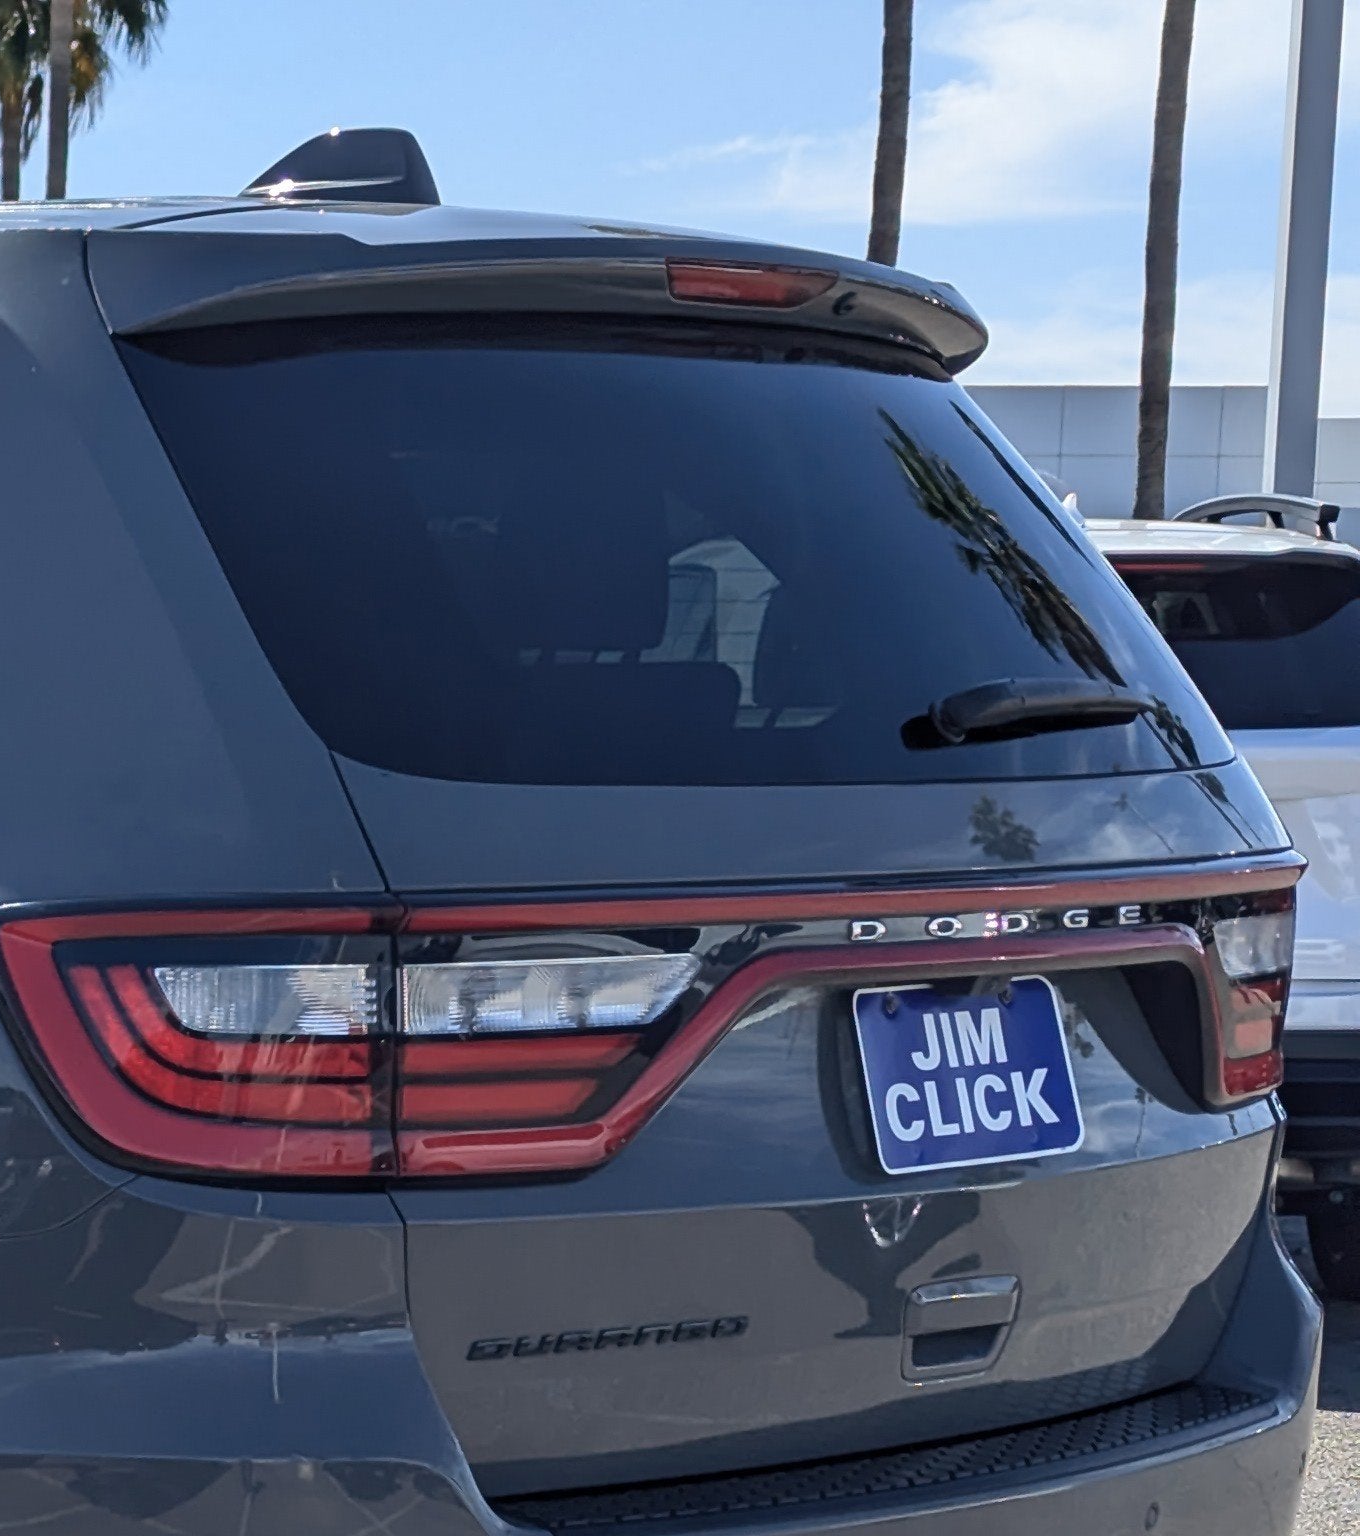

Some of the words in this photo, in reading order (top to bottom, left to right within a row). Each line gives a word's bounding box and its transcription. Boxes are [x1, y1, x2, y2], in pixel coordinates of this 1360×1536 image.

[851, 905, 1142, 941] DODGE
[910, 1007, 1008, 1071] JIM
[885, 1067, 1060, 1142] CLICK
[465, 1314, 751, 1362] DURANGO
